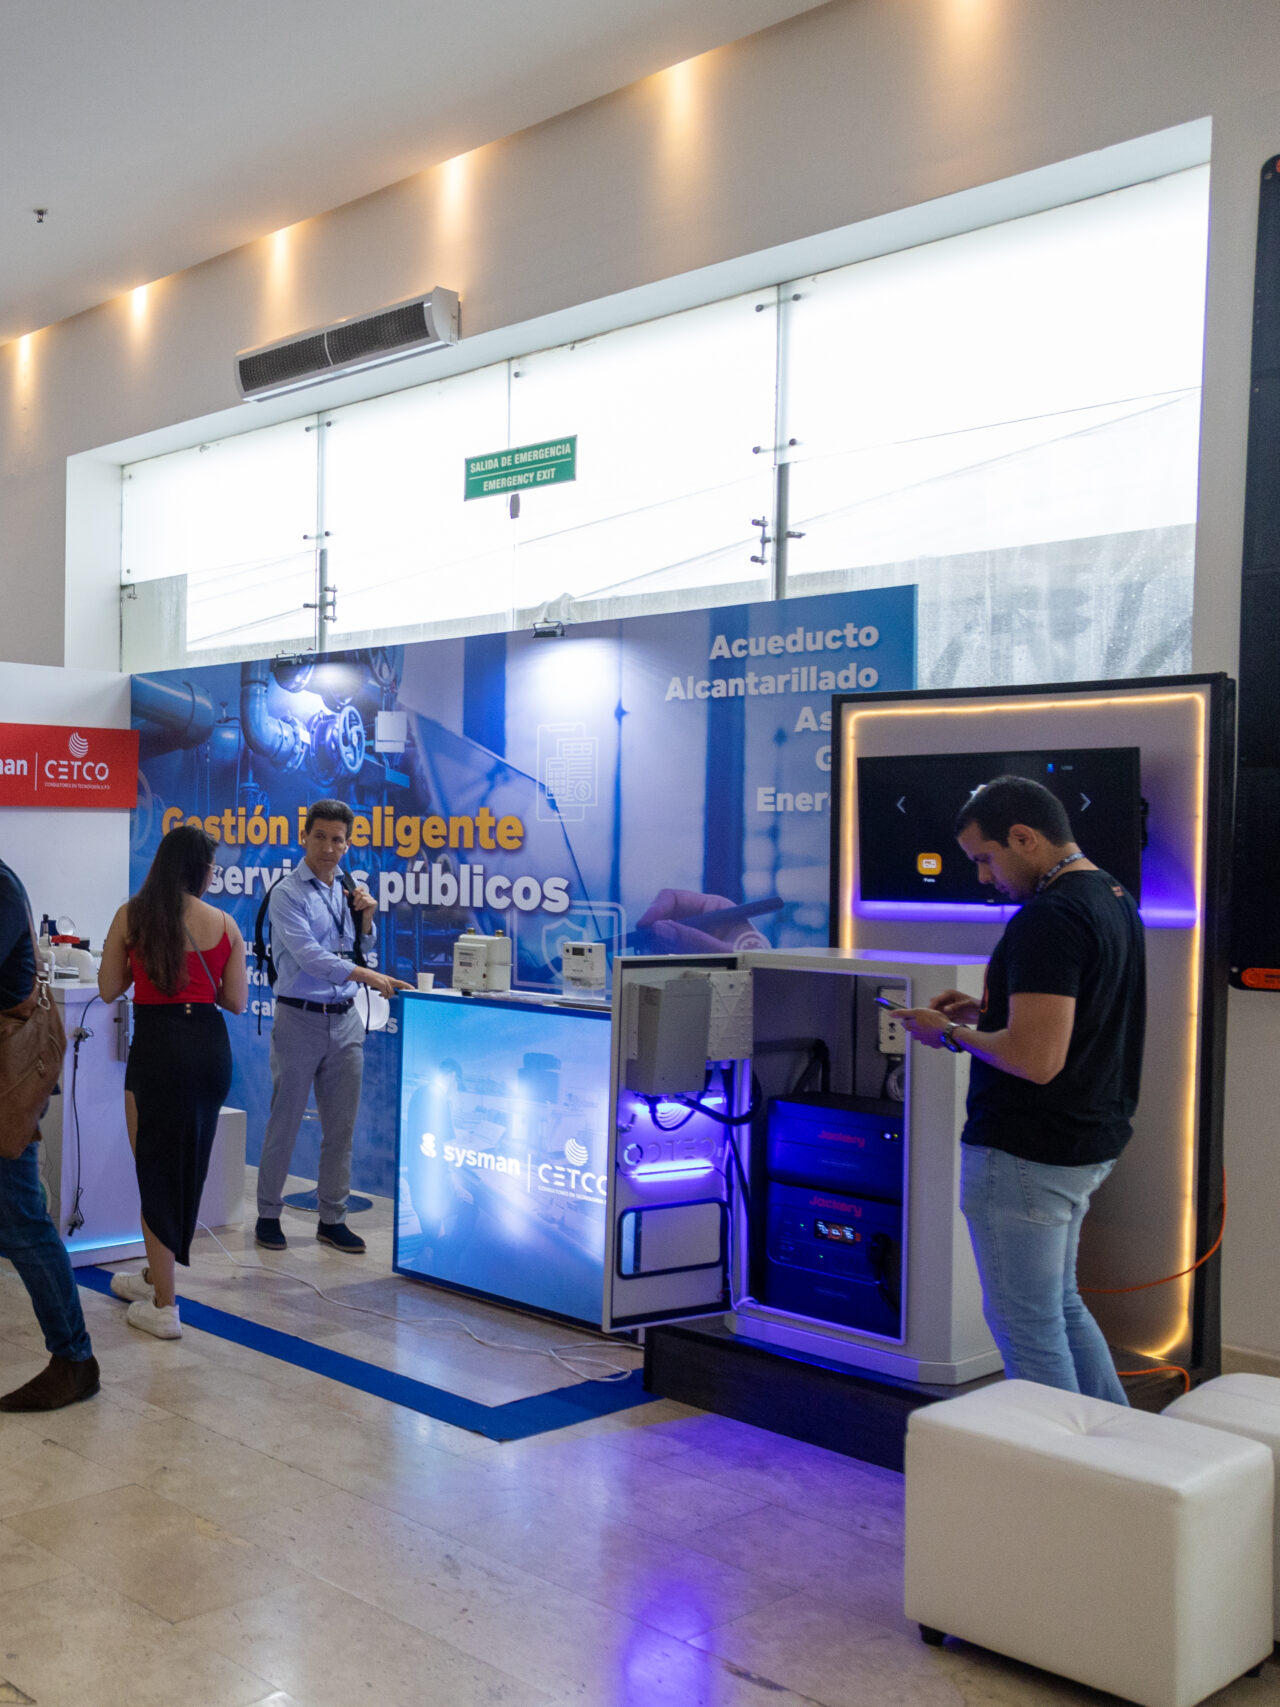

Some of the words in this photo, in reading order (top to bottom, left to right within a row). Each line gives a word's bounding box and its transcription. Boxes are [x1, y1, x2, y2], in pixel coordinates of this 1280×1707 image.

[470, 458, 499, 474] SALIDA
[501, 455, 513, 467] DE
[514, 443, 571, 465] EMERGENCIA
[483, 472, 535, 492] EMERGENCY
[536, 468, 557, 481] EXIT
[709, 622, 880, 660] Acueducto
[665, 663, 879, 701] Alcantarillado
[794, 706, 832, 732] As
[44, 759, 110, 781] CETCO
[756, 786, 831, 812] Ener
[298, 806, 525, 858] ieligente
[379, 860, 570, 913] públicos
[818, 1130, 865, 1148] Jackery
[443, 1144, 521, 1176] sysman
[809, 1195, 862, 1218] Jackery
